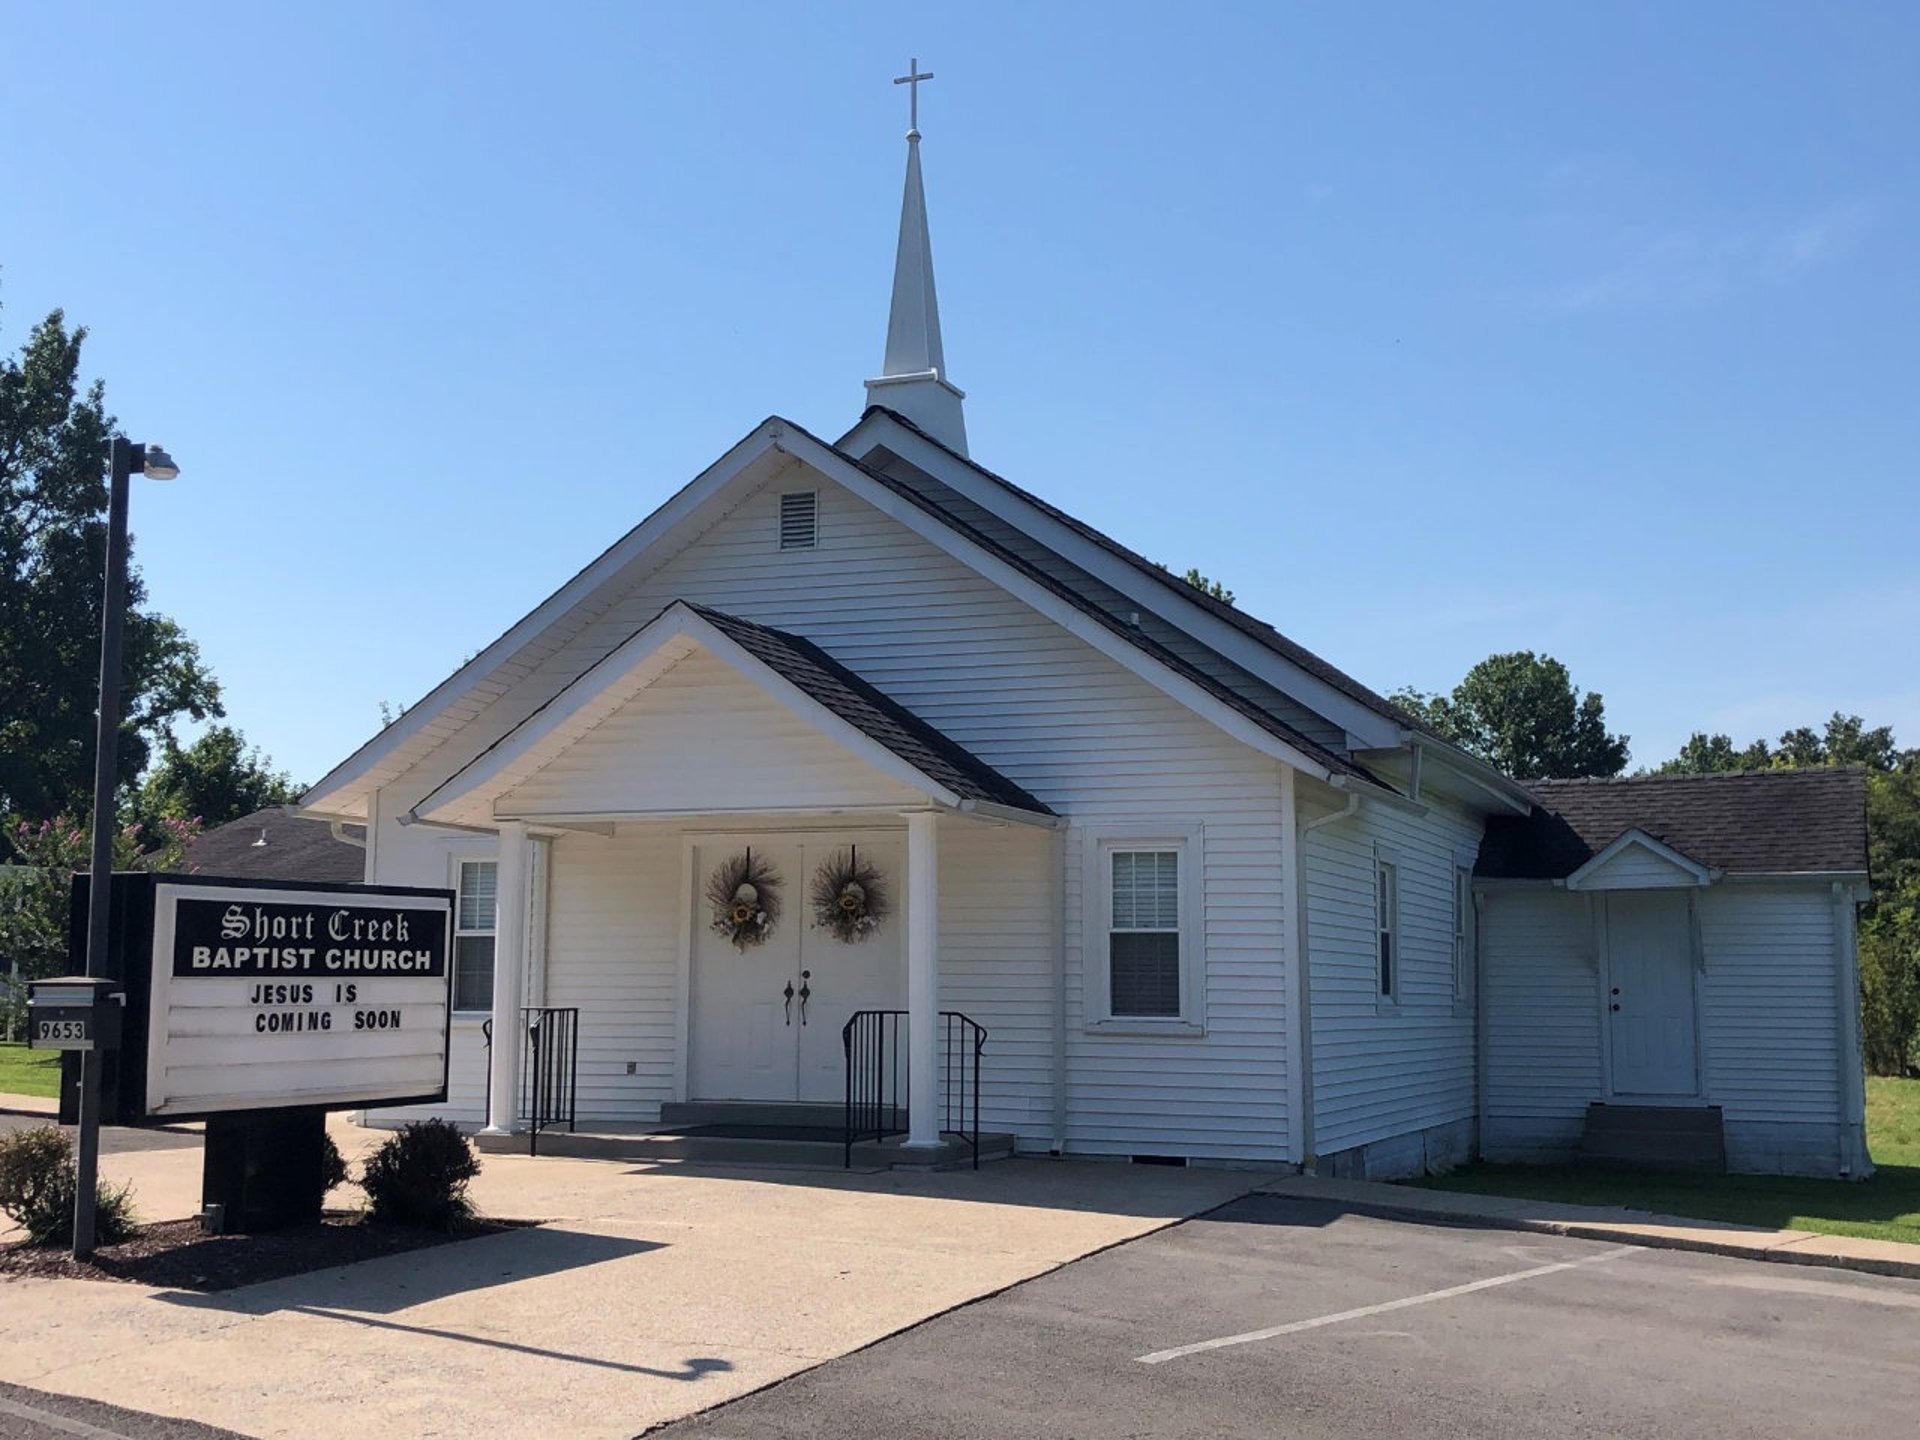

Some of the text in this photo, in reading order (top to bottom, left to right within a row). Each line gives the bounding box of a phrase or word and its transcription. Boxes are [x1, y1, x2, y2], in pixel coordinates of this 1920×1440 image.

[220, 904, 410, 944] Short Creek
[191, 946, 431, 970] BAPTIST CHURCH
[250, 983, 357, 1004] JESUS IS
[41, 1022, 84, 1040] 9653
[255, 1010, 401, 1033] COMING SOON
